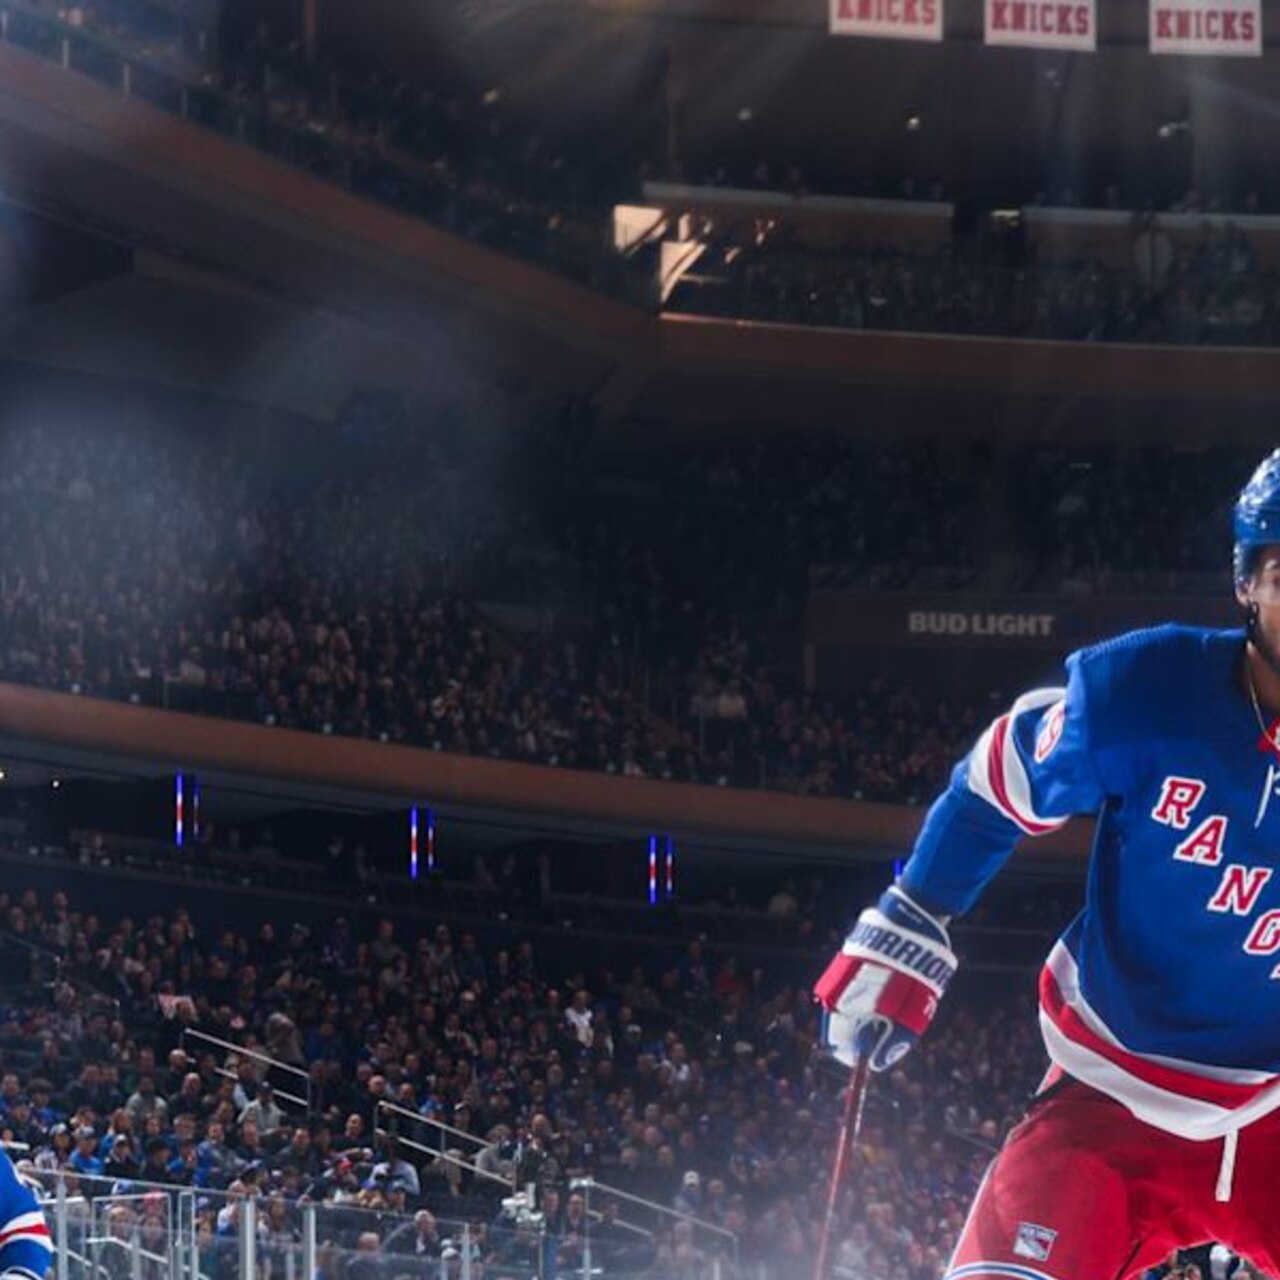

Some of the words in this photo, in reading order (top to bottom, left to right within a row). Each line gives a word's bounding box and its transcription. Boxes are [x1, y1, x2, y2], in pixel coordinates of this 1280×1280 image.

[835, 0, 937, 25] KNICKS
[990, 0, 1089, 35] KNICKS
[1154, 10, 1255, 41] KNICKS
[908, 612, 967, 634] BUD
[971, 613, 1055, 636] LIGHT
